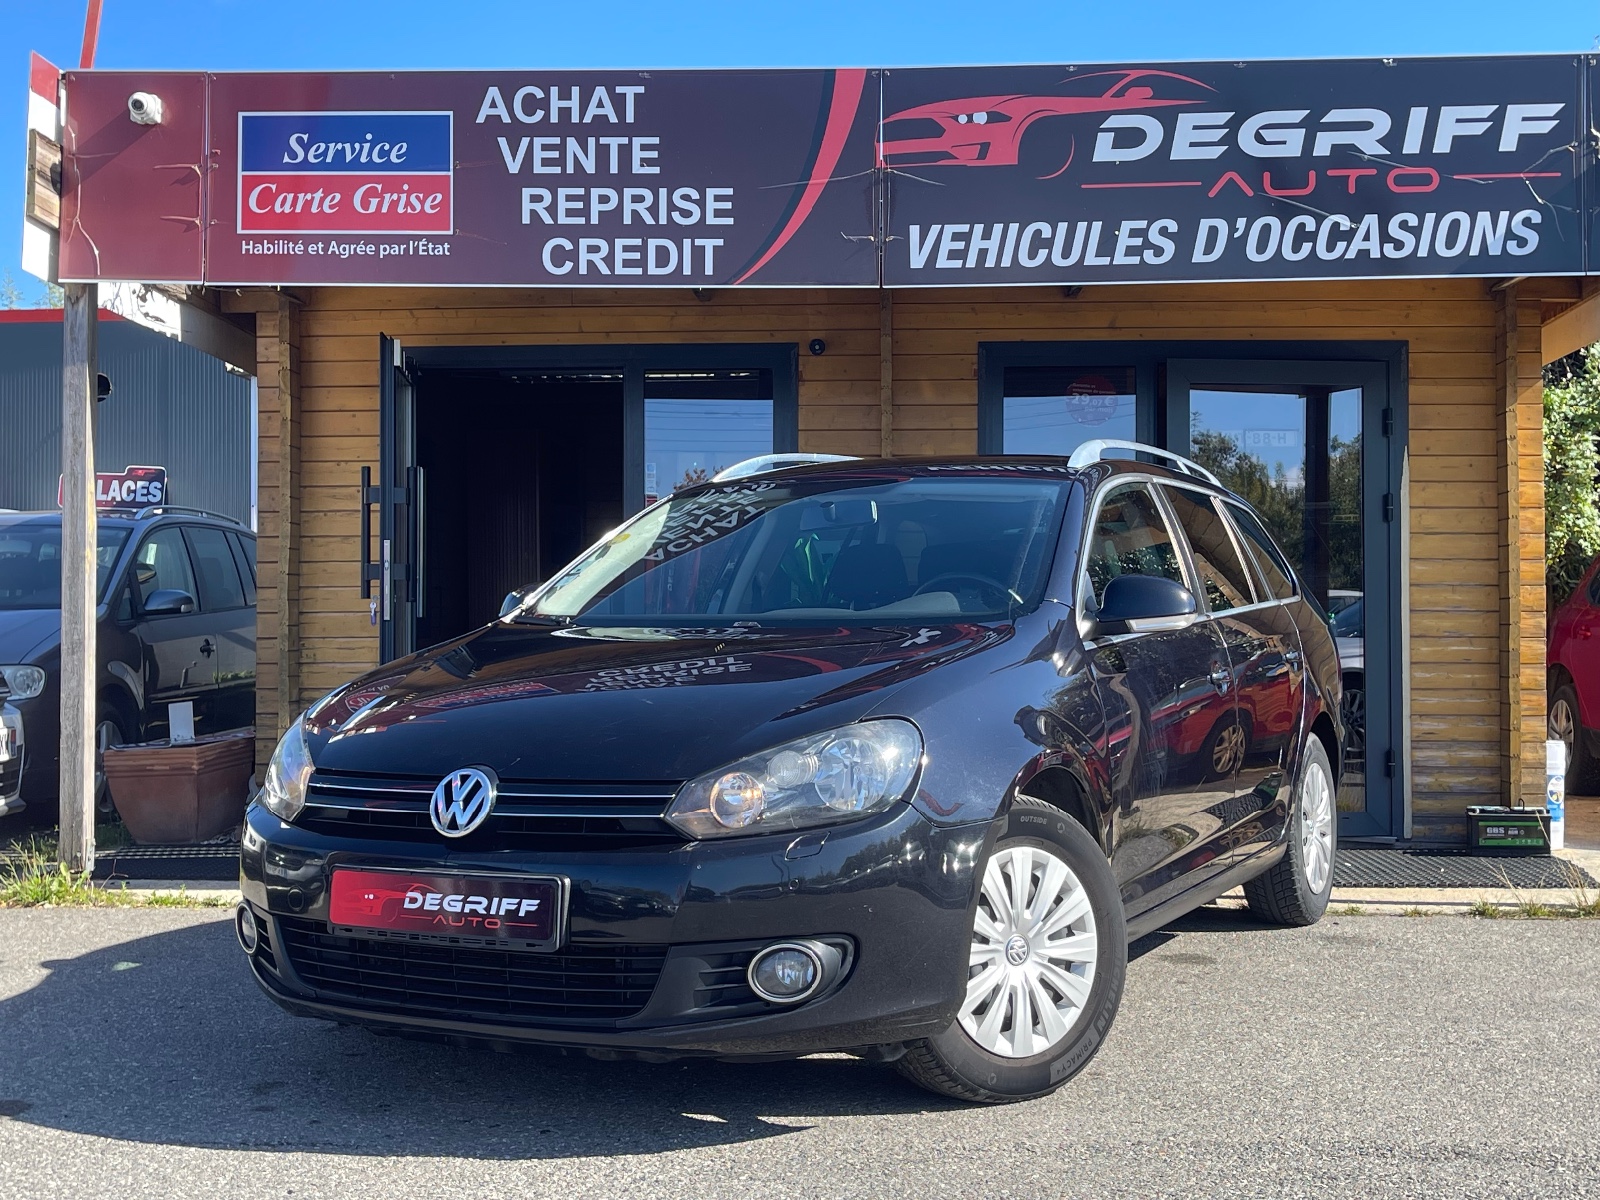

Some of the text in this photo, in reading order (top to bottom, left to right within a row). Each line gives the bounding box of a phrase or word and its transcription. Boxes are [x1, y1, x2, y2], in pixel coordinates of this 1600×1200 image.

[475, 85, 645, 124] ACHAT
[282, 132, 408, 164] Service
[1092, 102, 1566, 163] DEGRIFF
[497, 136, 661, 174] VENTE
[247, 182, 443, 214] Carte Grise
[1207, 166, 1441, 198] AUTO
[521, 187, 735, 226] REPRISE
[241, 239, 305, 256] Habilité
[307, 241, 325, 256] et
[328, 239, 376, 259] Agrée
[379, 243, 407, 259] par
[541, 237, 724, 276] CREDIT
[908, 218, 1179, 269] VEHICULES
[96, 479, 163, 503] LACES
[403, 891, 541, 917] DEGRIFF
[432, 914, 501, 929] AUTO
